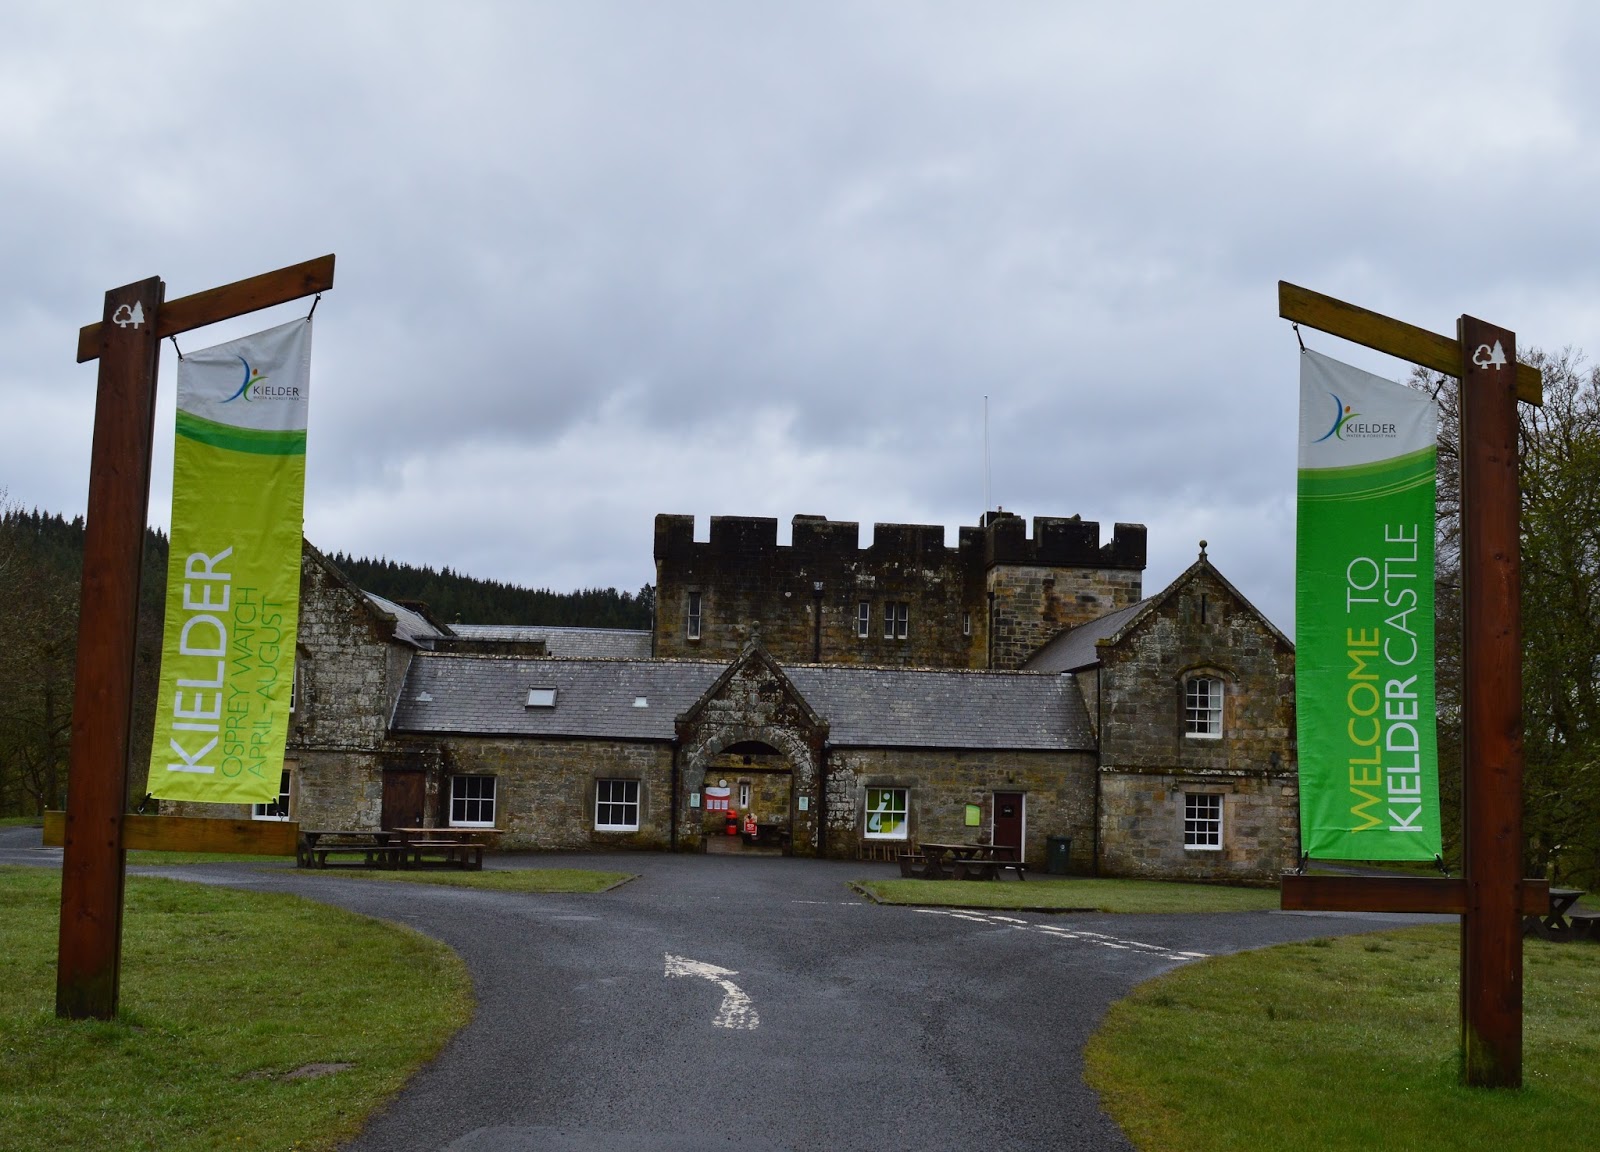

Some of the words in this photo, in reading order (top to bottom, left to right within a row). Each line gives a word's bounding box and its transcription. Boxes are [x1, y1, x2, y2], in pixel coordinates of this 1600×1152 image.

[253, 386, 299, 396] KIELDER
[1346, 424, 1396, 434] KIELDER
[230, 587, 258, 677] WATCH
[1346, 557, 1380, 614] TO
[1384, 524, 1418, 666] CASTLE
[167, 546, 233, 774] KIELDER
[221, 683, 250, 778] OSPREY
[1347, 628, 1383, 833] WELCOME
[1384, 674, 1422, 832] KIELDER
